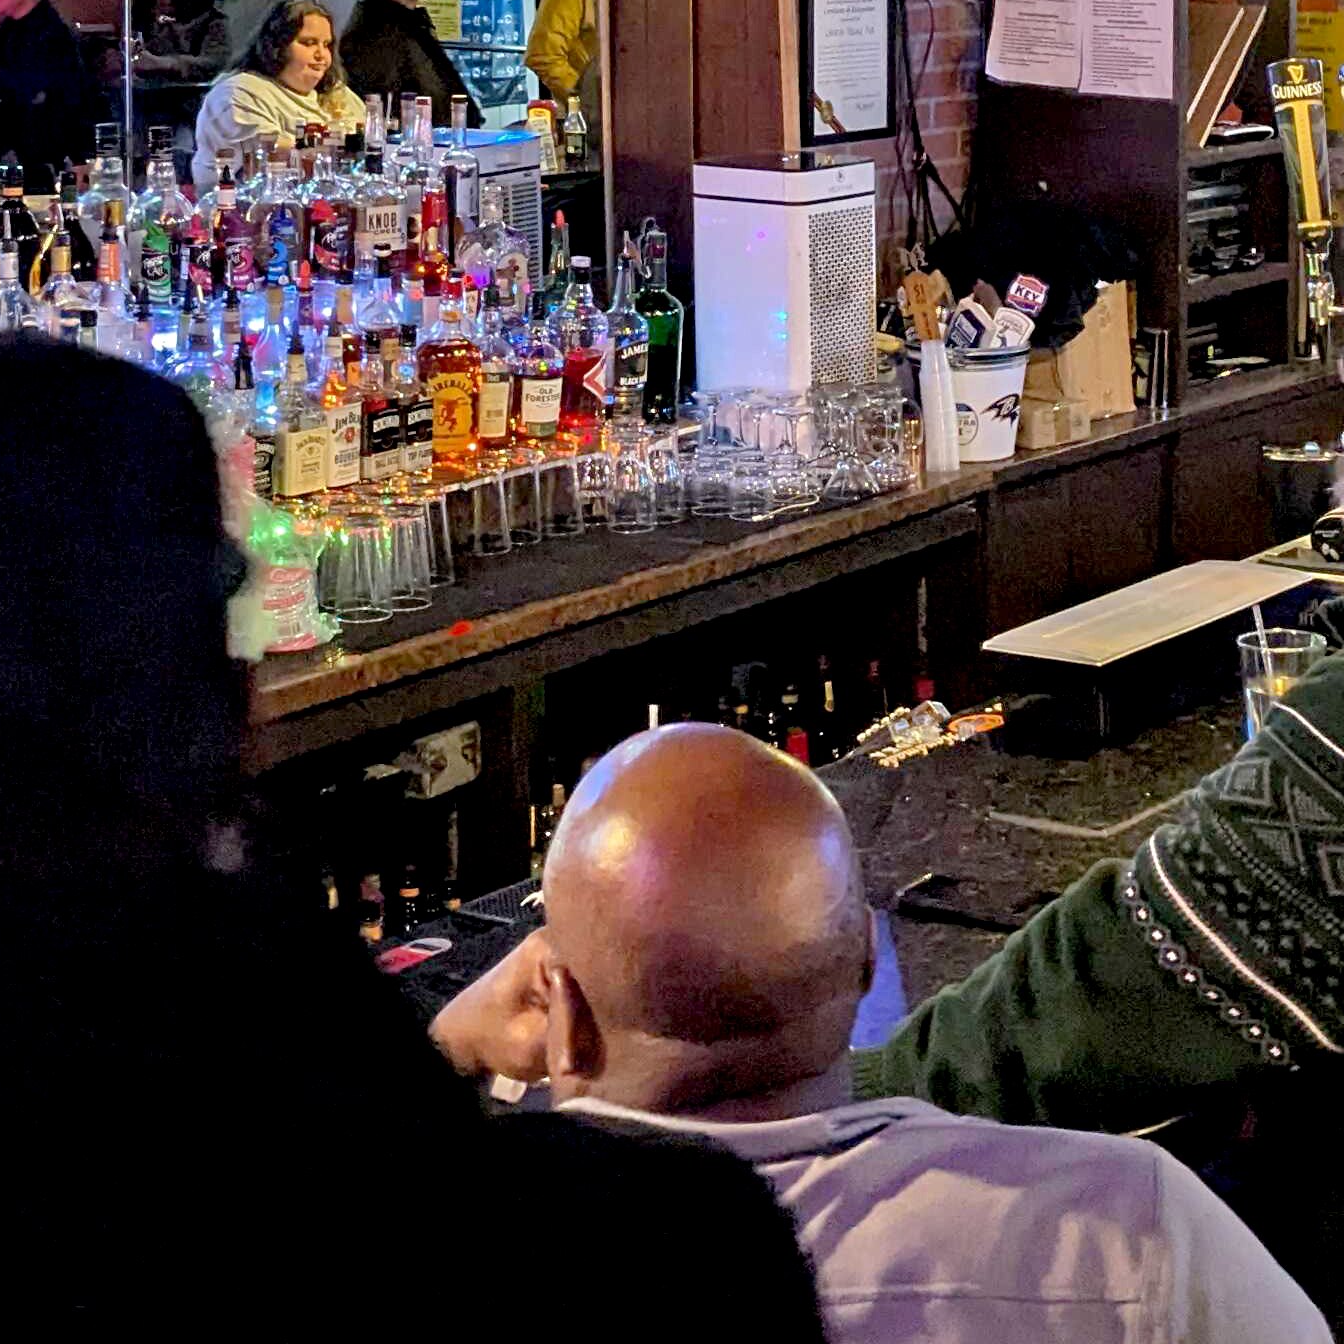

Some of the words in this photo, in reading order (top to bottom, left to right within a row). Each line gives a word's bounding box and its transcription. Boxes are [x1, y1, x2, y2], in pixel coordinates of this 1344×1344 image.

[1271, 81, 1322, 100] GUINNESS
[368, 212, 397, 230] KNOB
[1014, 285, 1039, 302] KEY
[620, 344, 649, 361] JAME
[538, 387, 554, 396] OLD
[332, 414, 348, 434] JIM
[347, 411, 362, 425] BEA
